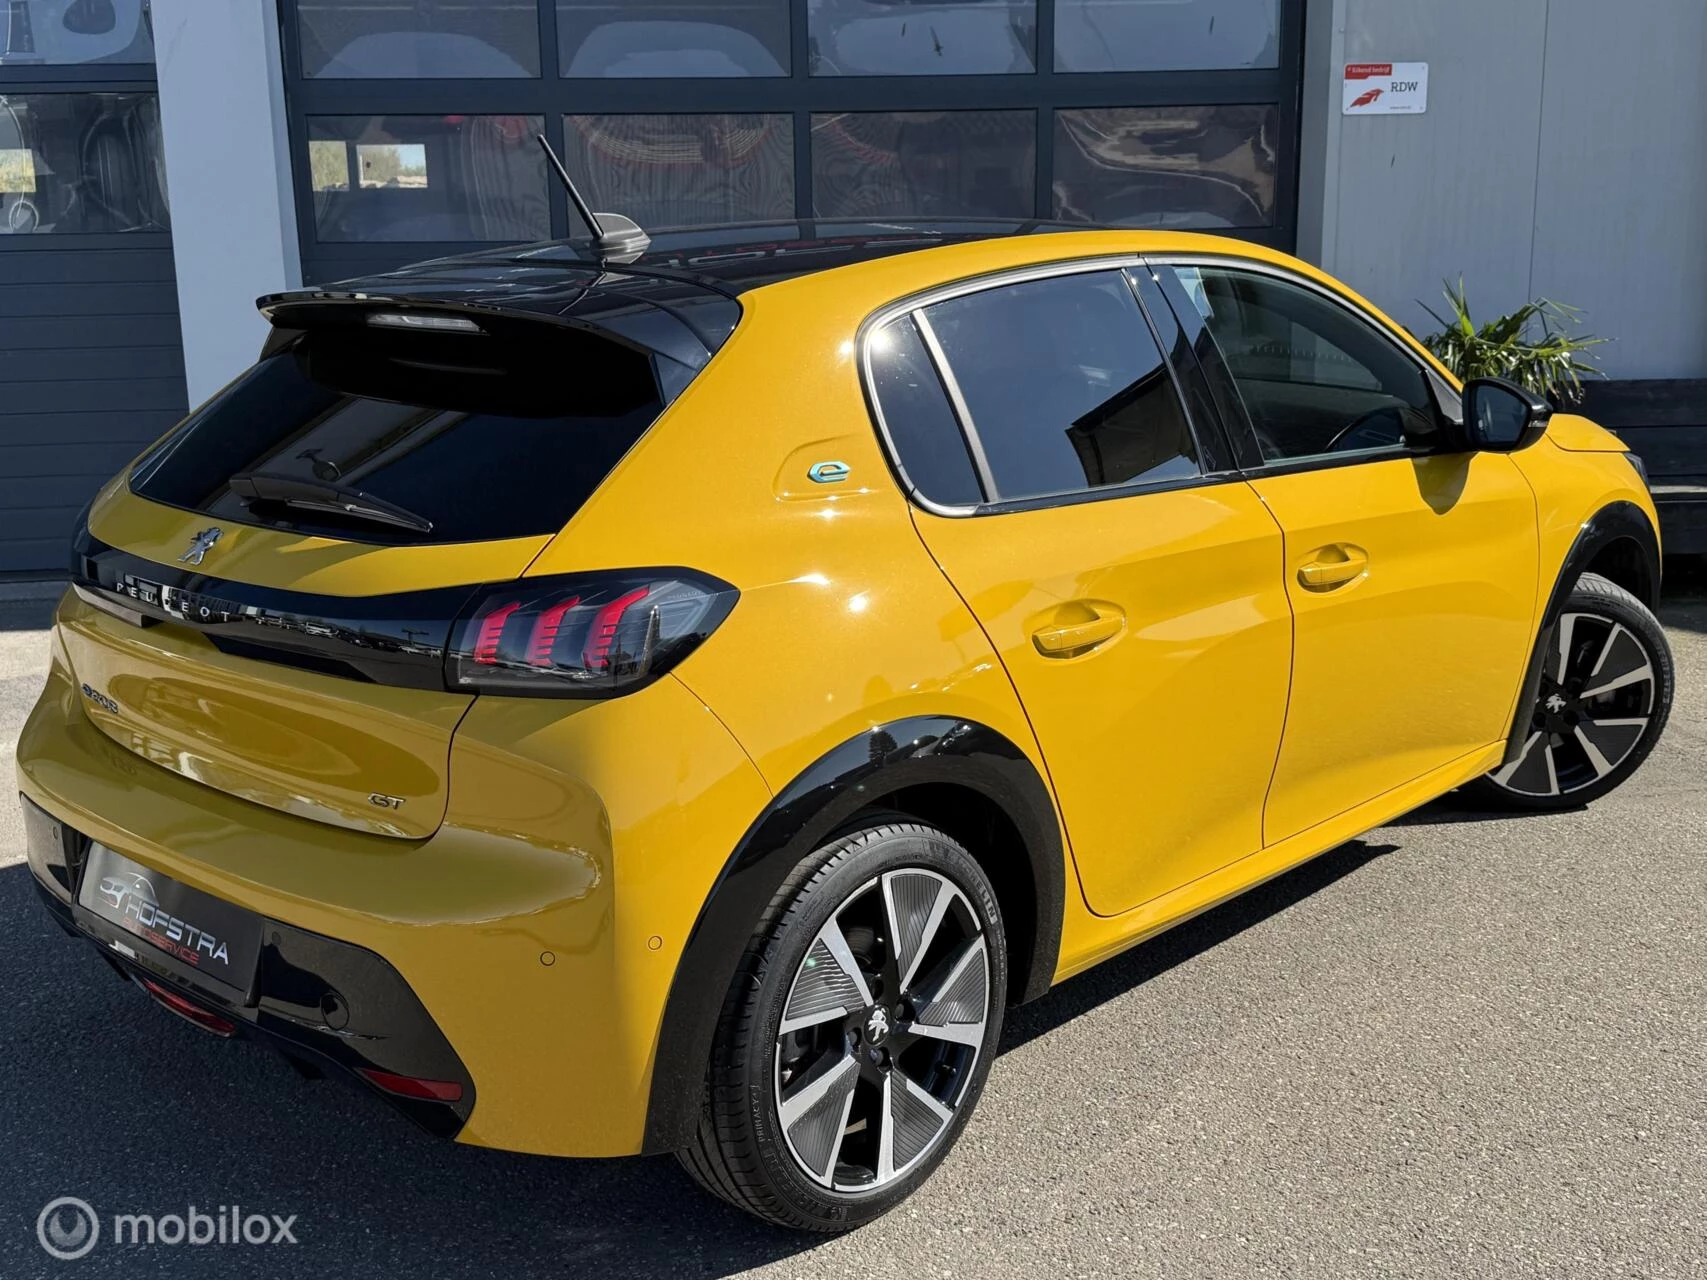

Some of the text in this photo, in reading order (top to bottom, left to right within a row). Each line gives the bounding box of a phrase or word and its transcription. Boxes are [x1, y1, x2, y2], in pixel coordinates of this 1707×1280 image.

[1390, 81, 1418, 93] RDW
[368, 792, 406, 810] GT
[125, 895, 229, 965] HOFSTRA
